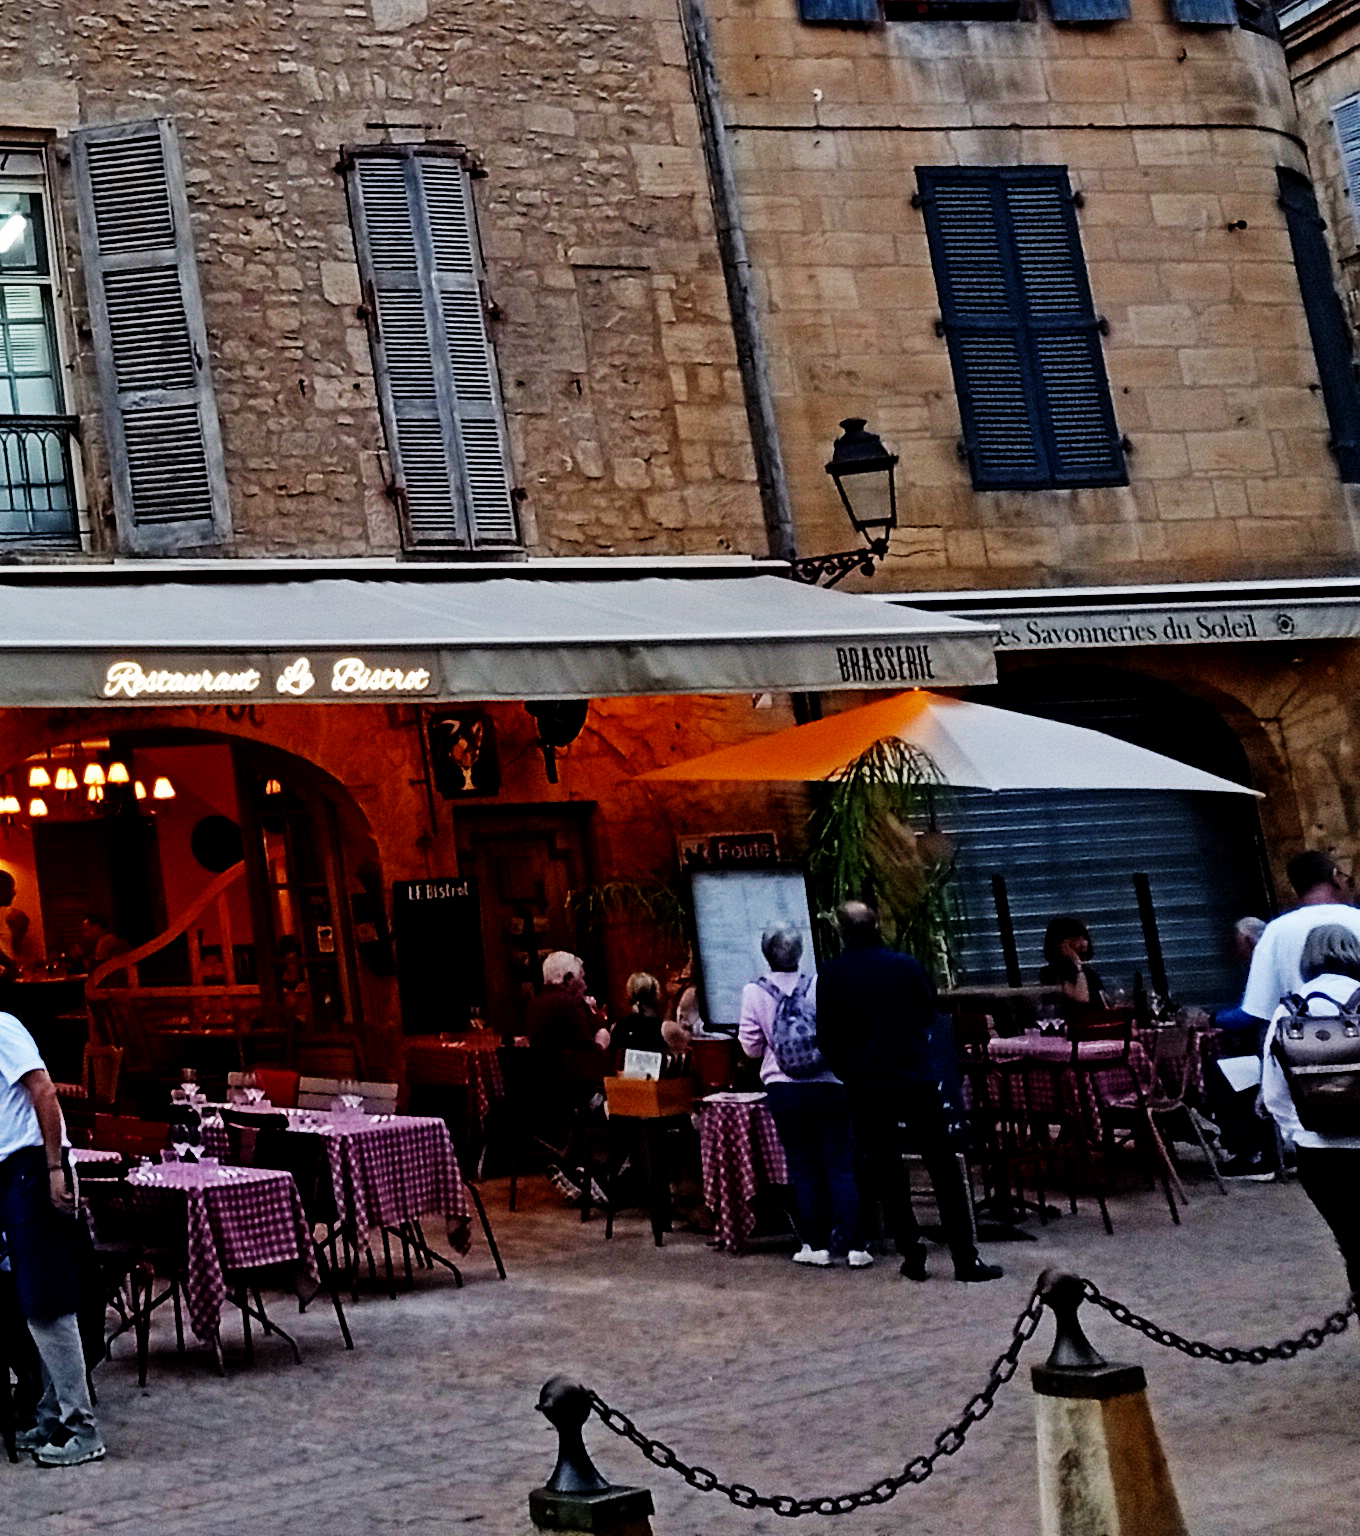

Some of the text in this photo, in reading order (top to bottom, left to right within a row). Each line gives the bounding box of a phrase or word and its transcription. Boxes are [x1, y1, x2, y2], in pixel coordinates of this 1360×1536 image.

[1027, 617, 1157, 645] Savonneries
[1162, 616, 1192, 640] du
[1196, 614, 1258, 639] Soleil
[104, 656, 430, 697] Restaurant Le Bistrot
[836, 645, 935, 682] BRASSERIE
